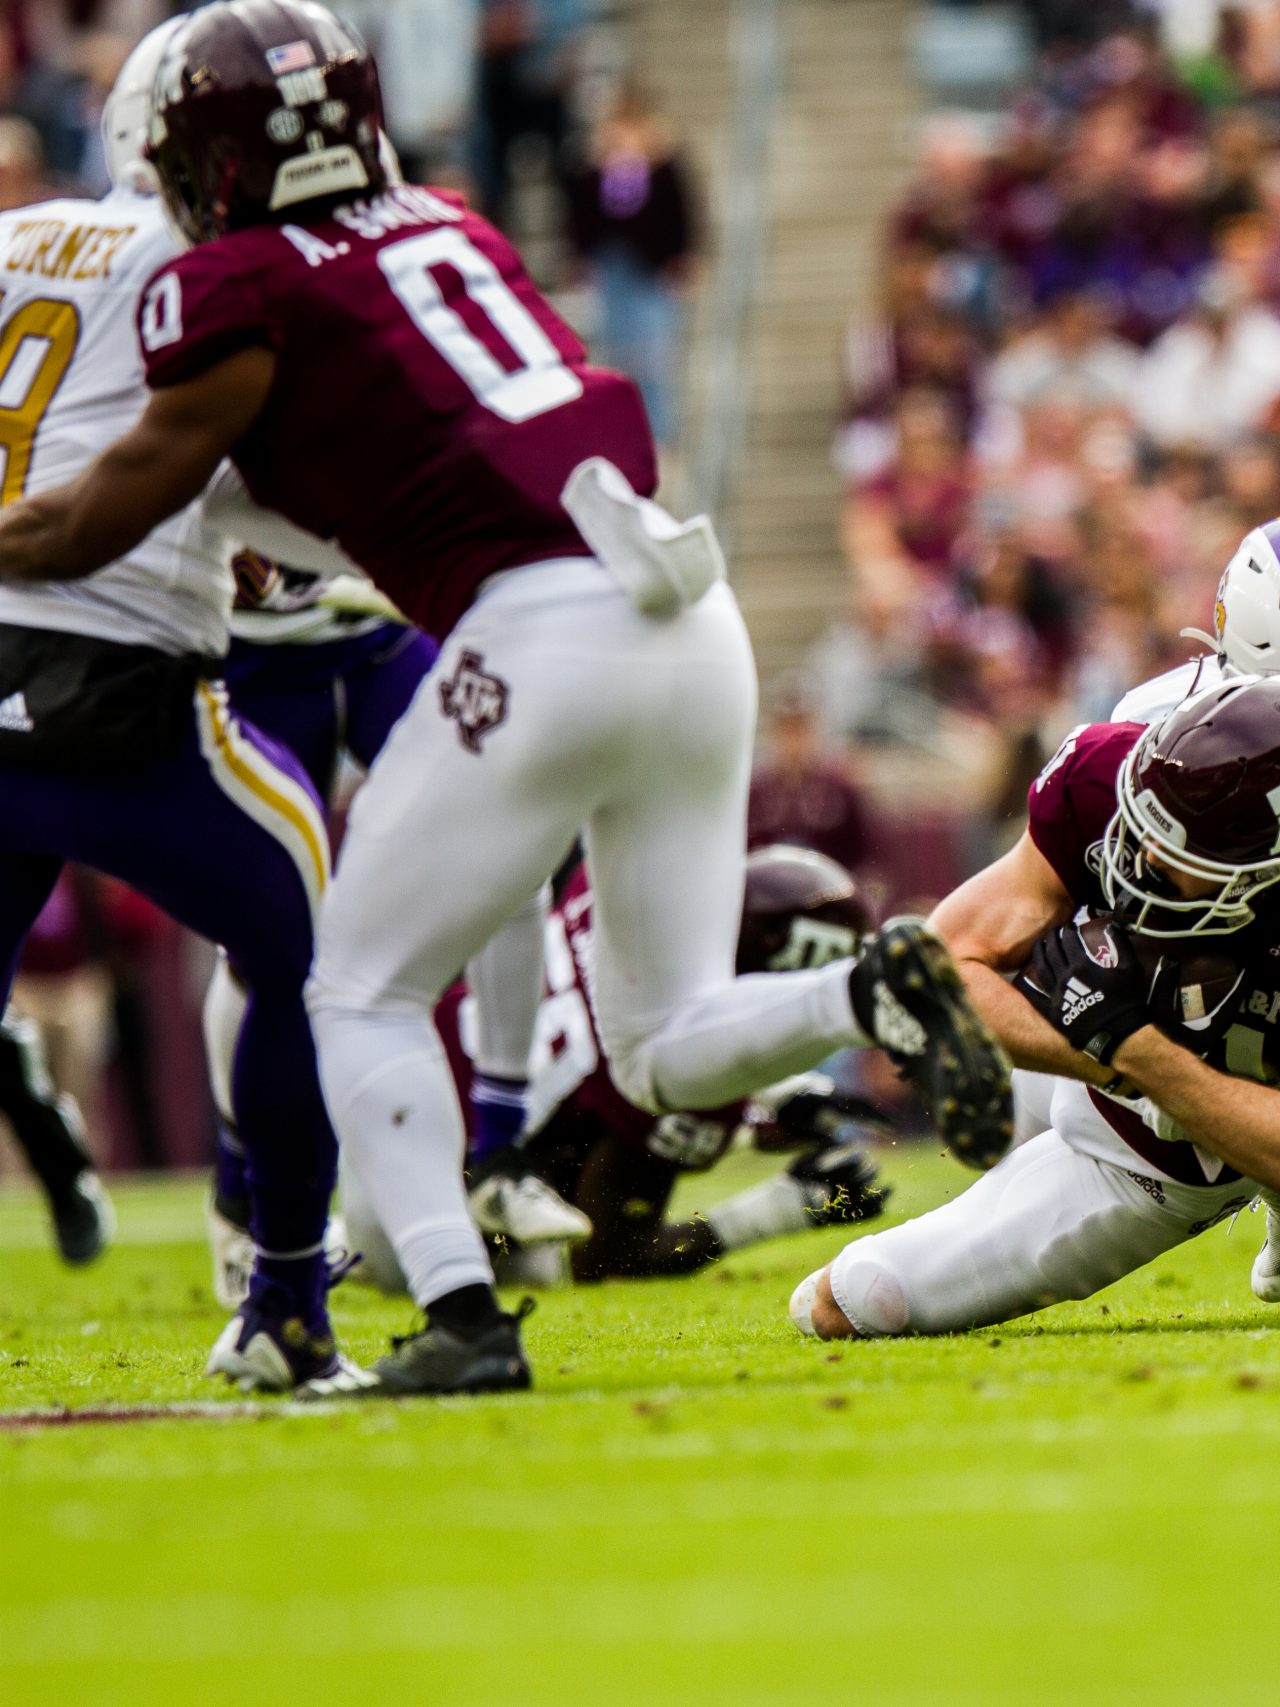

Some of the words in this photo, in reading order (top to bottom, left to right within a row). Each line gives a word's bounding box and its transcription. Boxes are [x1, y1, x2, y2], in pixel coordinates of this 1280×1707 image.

[142, 271, 184, 352] 0
[376, 226, 583, 424] 0
[0, 296, 81, 508] 9
[1145, 800, 1173, 834] AGGIES
[1062, 990, 1105, 1026] adidas
[1127, 1169, 1167, 1204] adidas
